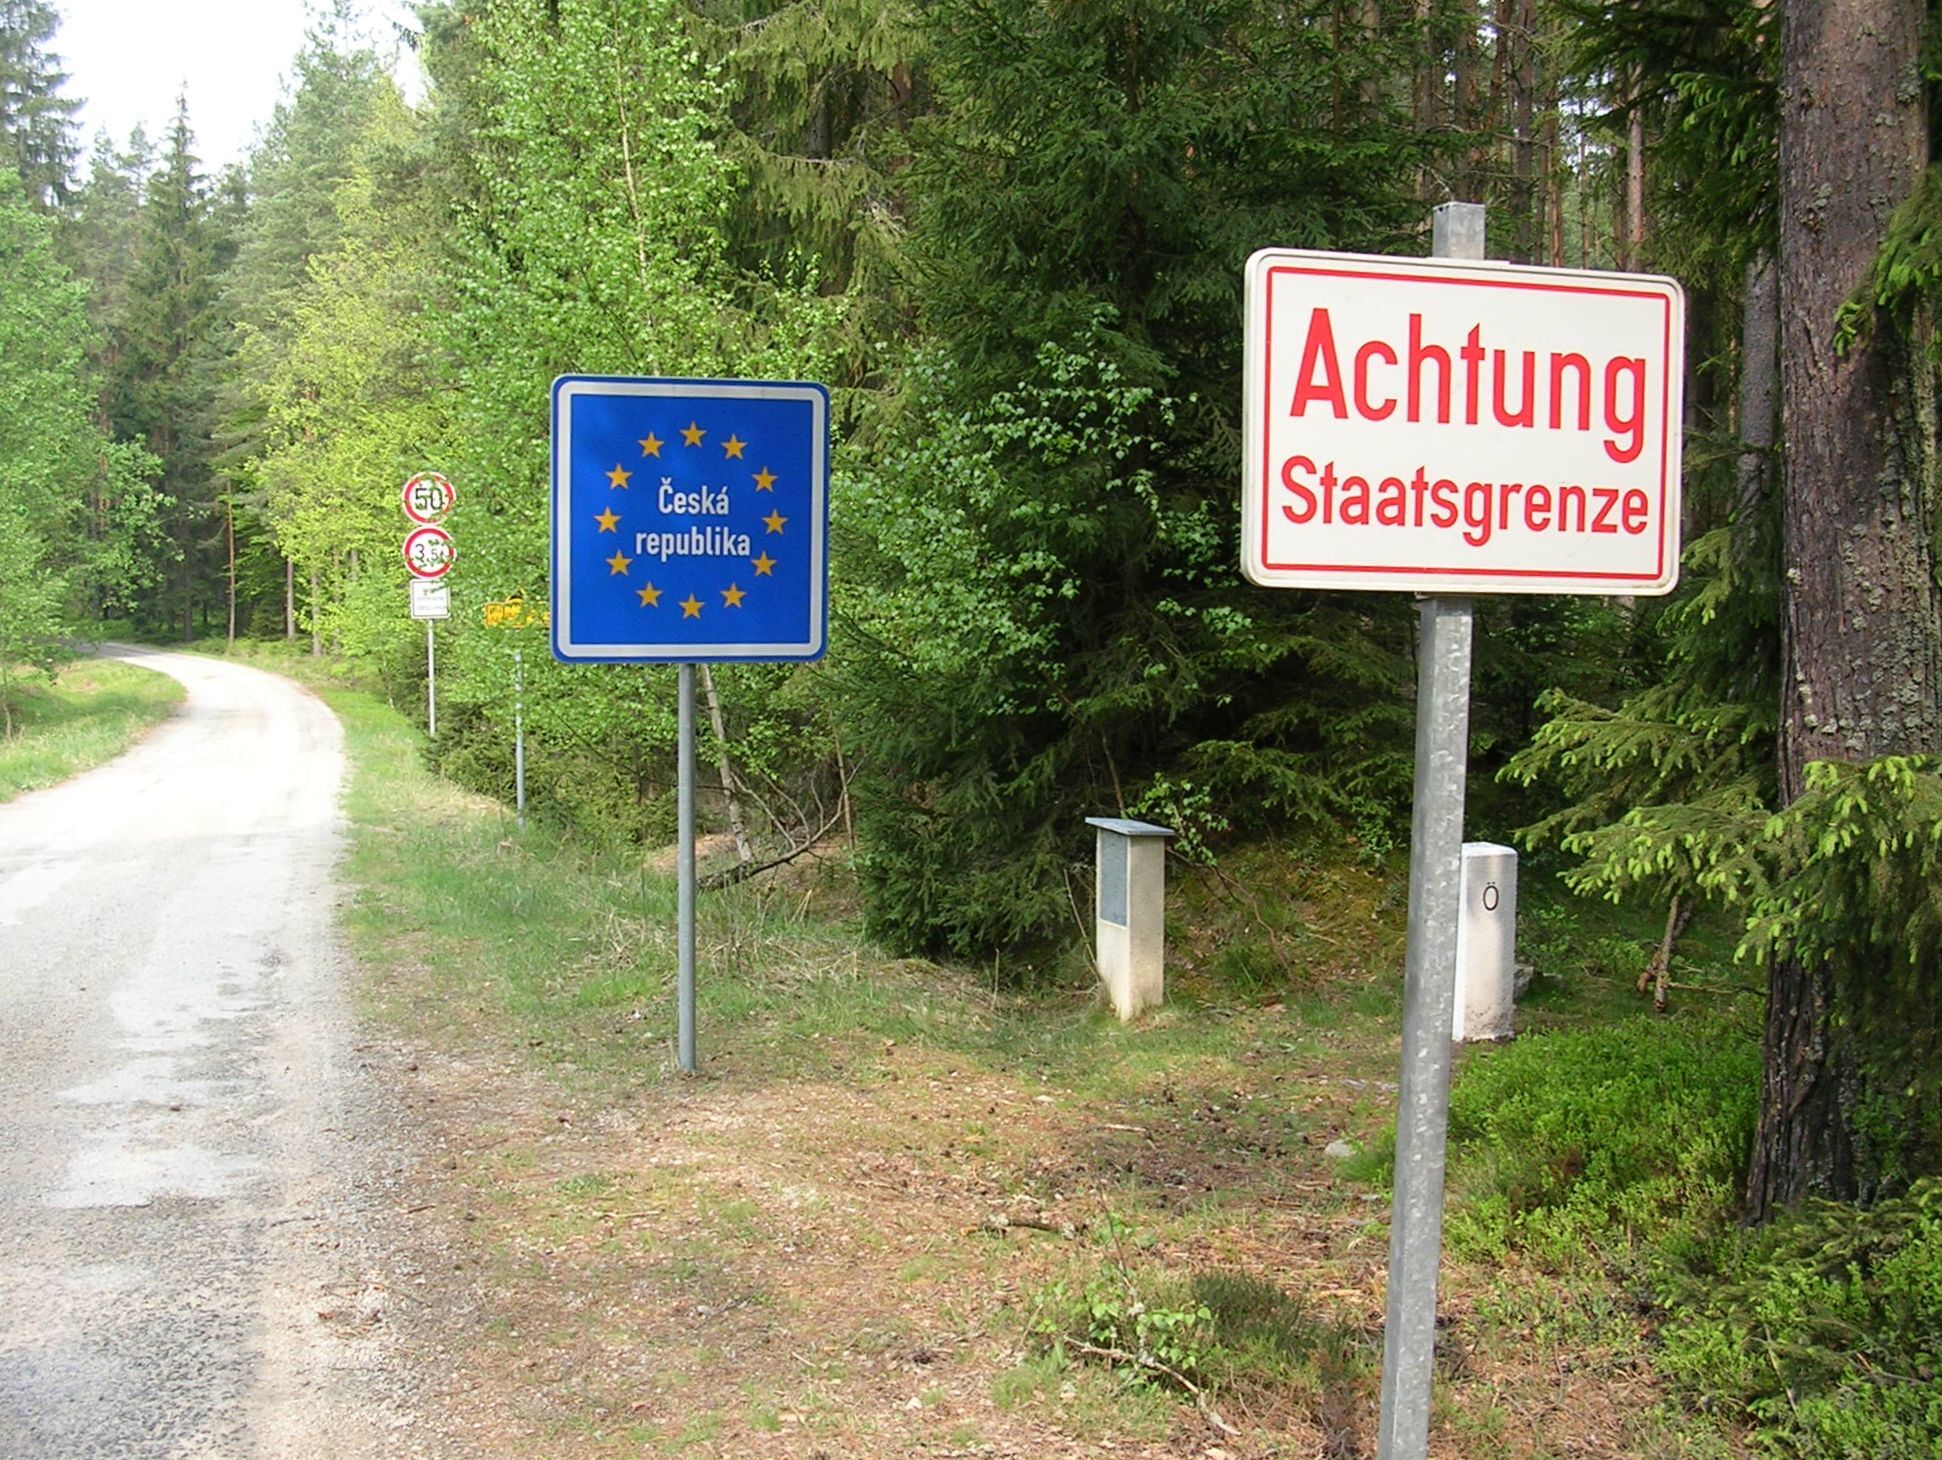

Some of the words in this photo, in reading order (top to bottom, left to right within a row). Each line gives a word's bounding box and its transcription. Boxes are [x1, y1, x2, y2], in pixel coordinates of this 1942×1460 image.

[1290, 308, 1646, 463] Achtung
[415, 488, 443, 510] 50
[658, 477, 729, 514] Česká
[1281, 455, 1648, 547] Staatsgrenze
[636, 526, 750, 562] republika
[1482, 881, 1500, 912] Ö
